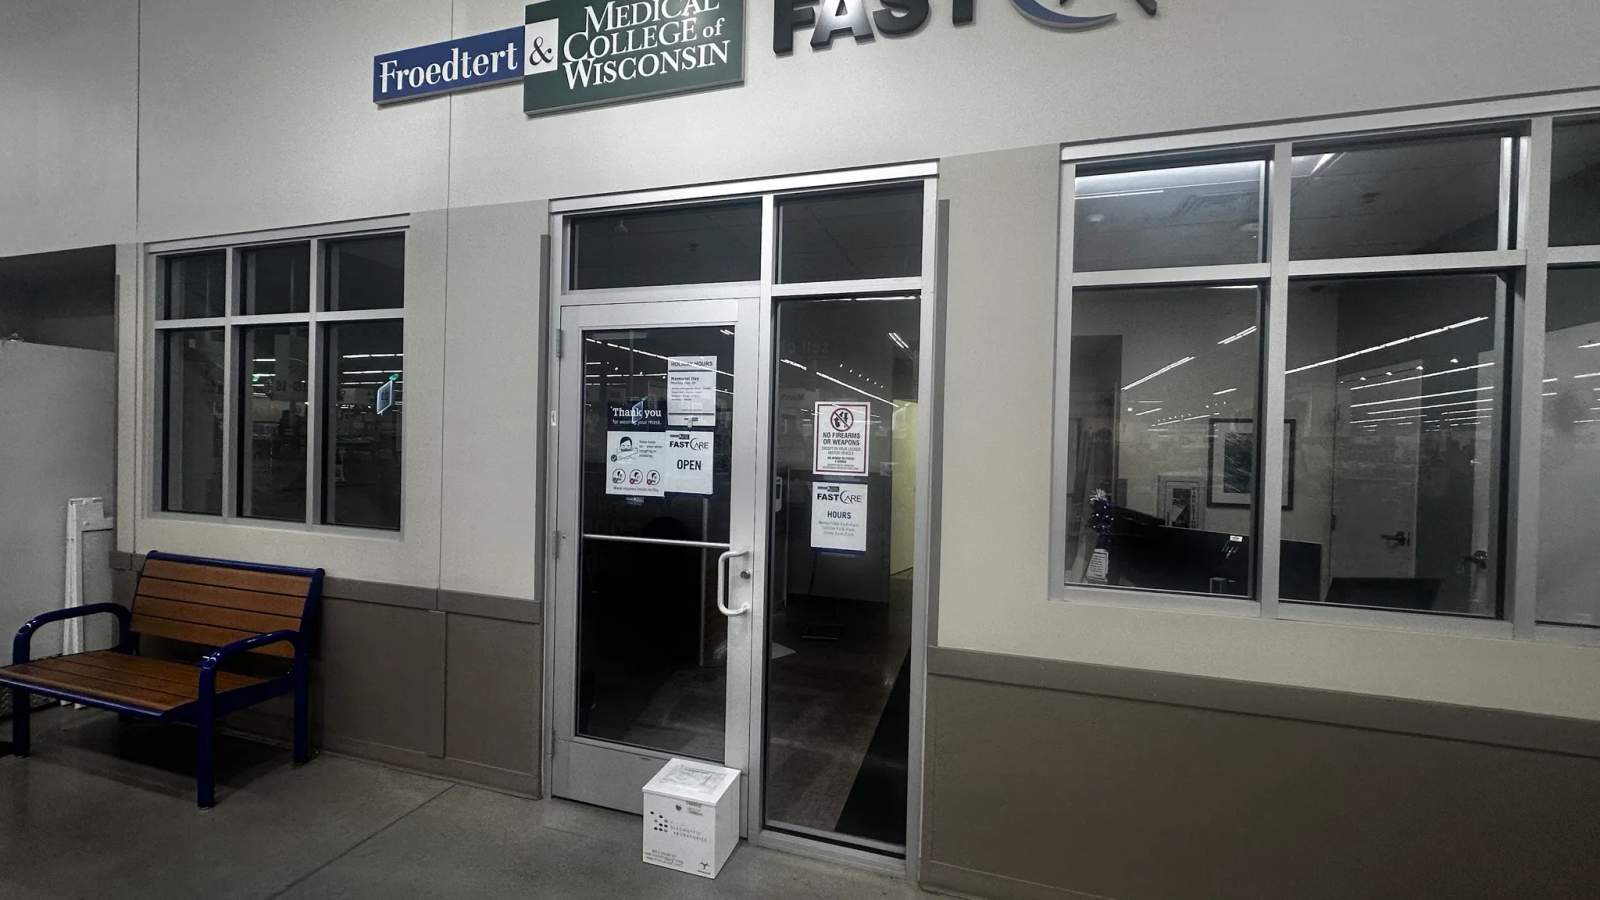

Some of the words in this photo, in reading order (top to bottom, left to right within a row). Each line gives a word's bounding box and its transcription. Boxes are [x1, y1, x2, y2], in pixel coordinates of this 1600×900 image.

[584, 0, 720, 33] MEDICAL
[529, 36, 554, 65] &
[563, 17, 697, 62] COLLEGE
[703, 17, 725, 38] of
[379, 42, 518, 93] Froedtert
[562, 40, 731, 90] WISCONSIN
[612, 407, 643, 417] Thank
[644, 409, 662, 419] you
[677, 459, 702, 471] OPEN
[827, 510, 852, 519] HOURS
